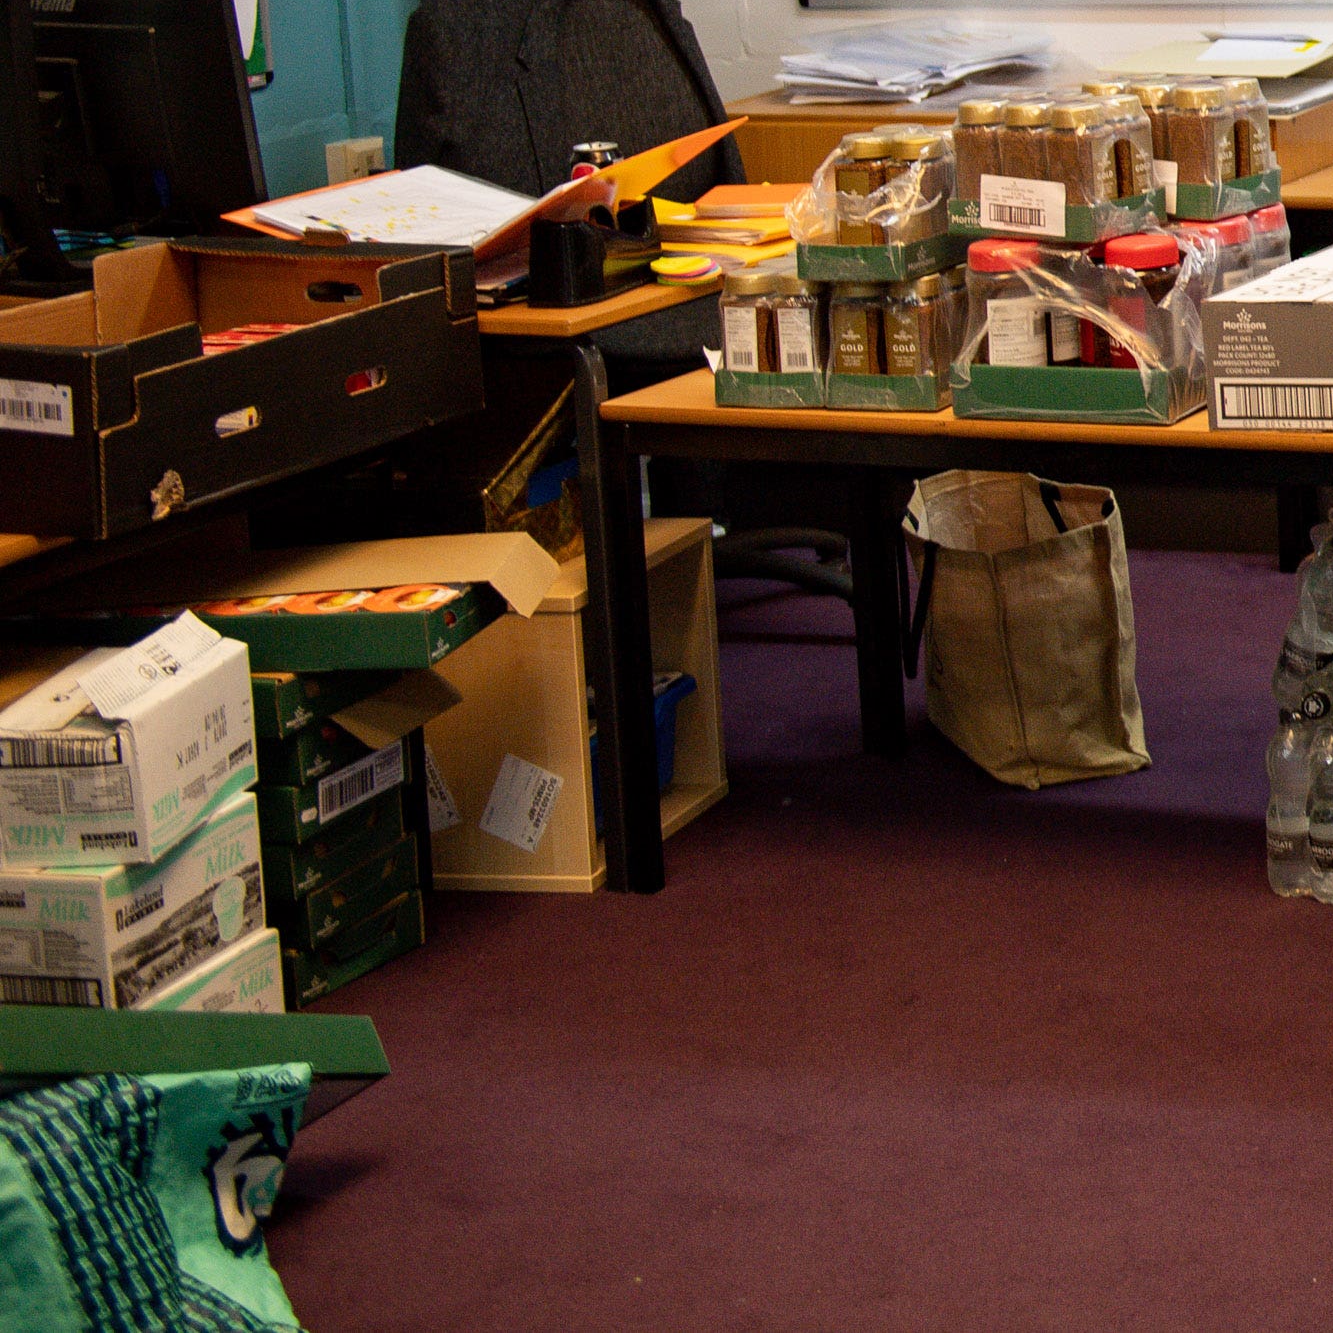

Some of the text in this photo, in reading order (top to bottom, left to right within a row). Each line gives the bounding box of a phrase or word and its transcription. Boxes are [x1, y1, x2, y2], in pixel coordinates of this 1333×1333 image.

[1223, 321, 1266, 330] Morrisons
[840, 344, 864, 352] GOLD
[892, 344, 915, 352] GOLD
[204, 841, 246, 882] Milk
[238, 968, 273, 1002] Milk
